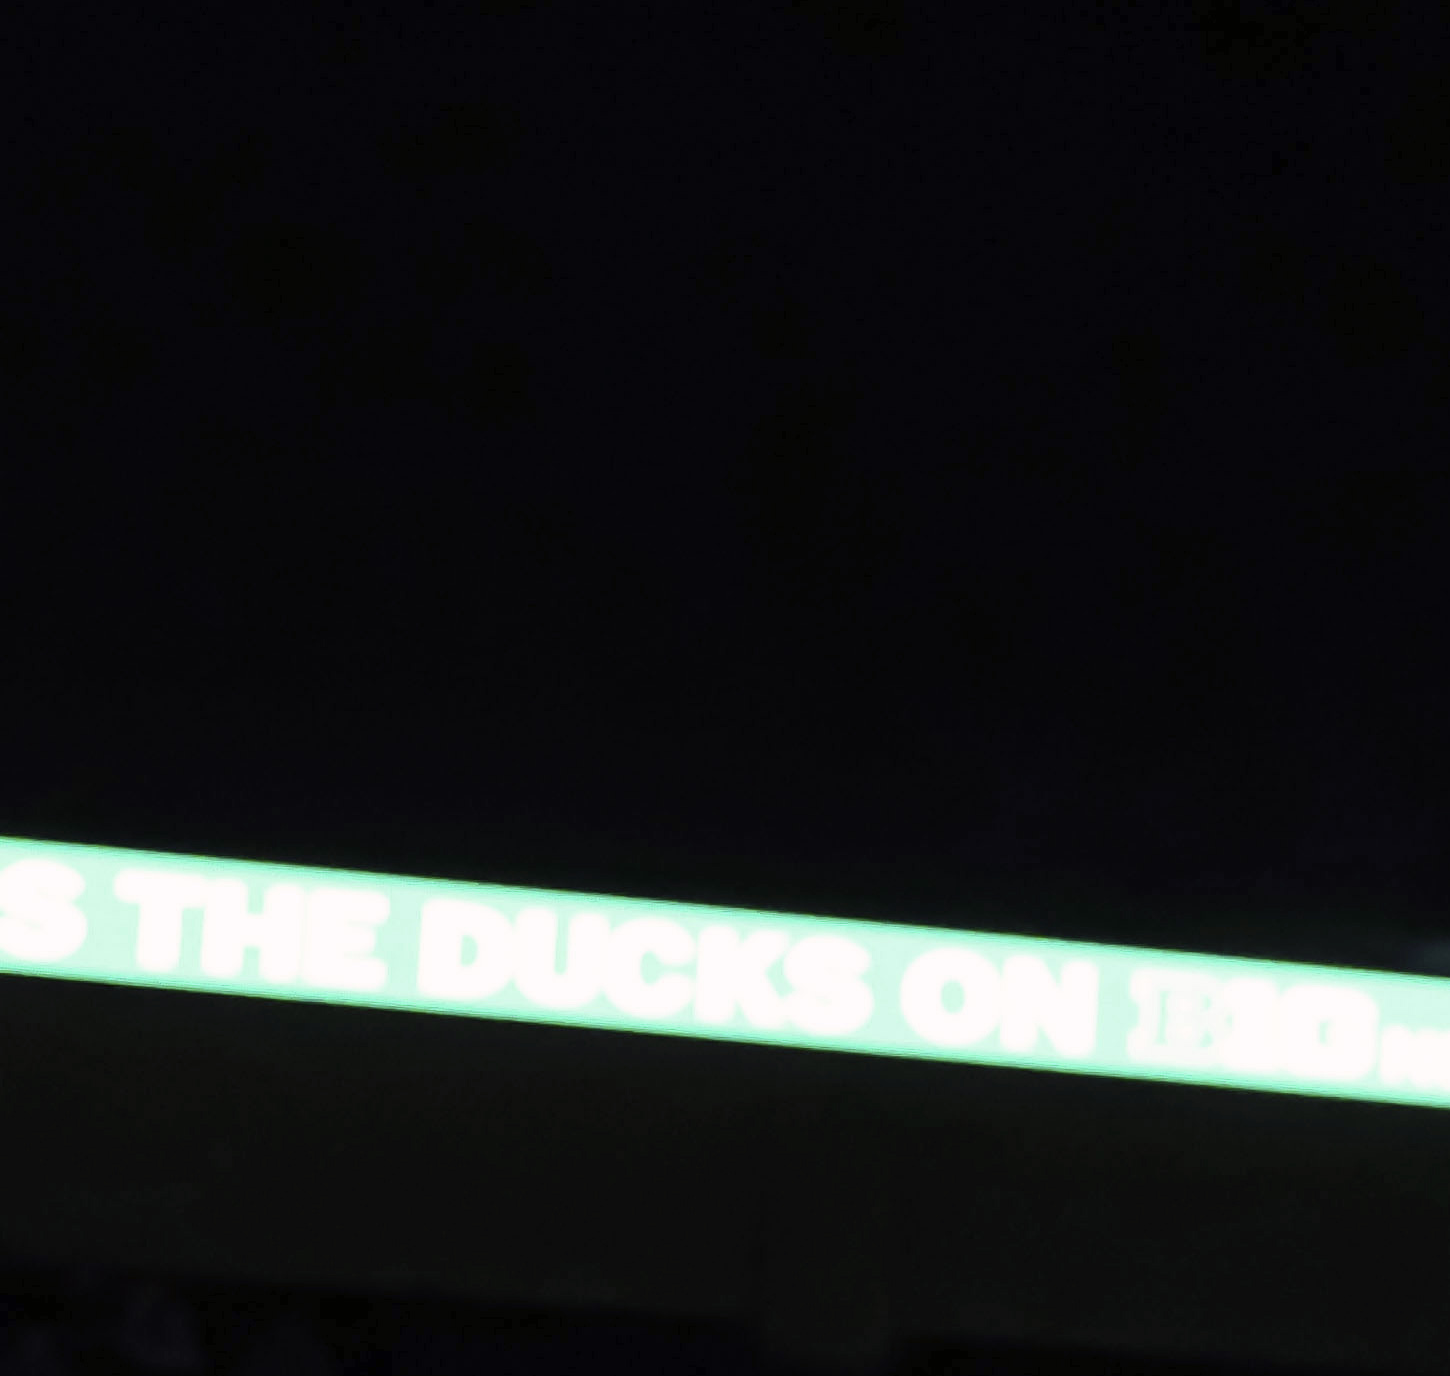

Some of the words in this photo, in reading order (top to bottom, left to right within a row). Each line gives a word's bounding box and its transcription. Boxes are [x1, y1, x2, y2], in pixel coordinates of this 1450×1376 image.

[115, 868, 392, 993] THE
[417, 896, 874, 1041] DUCKS
[900, 945, 1099, 1057] ON
